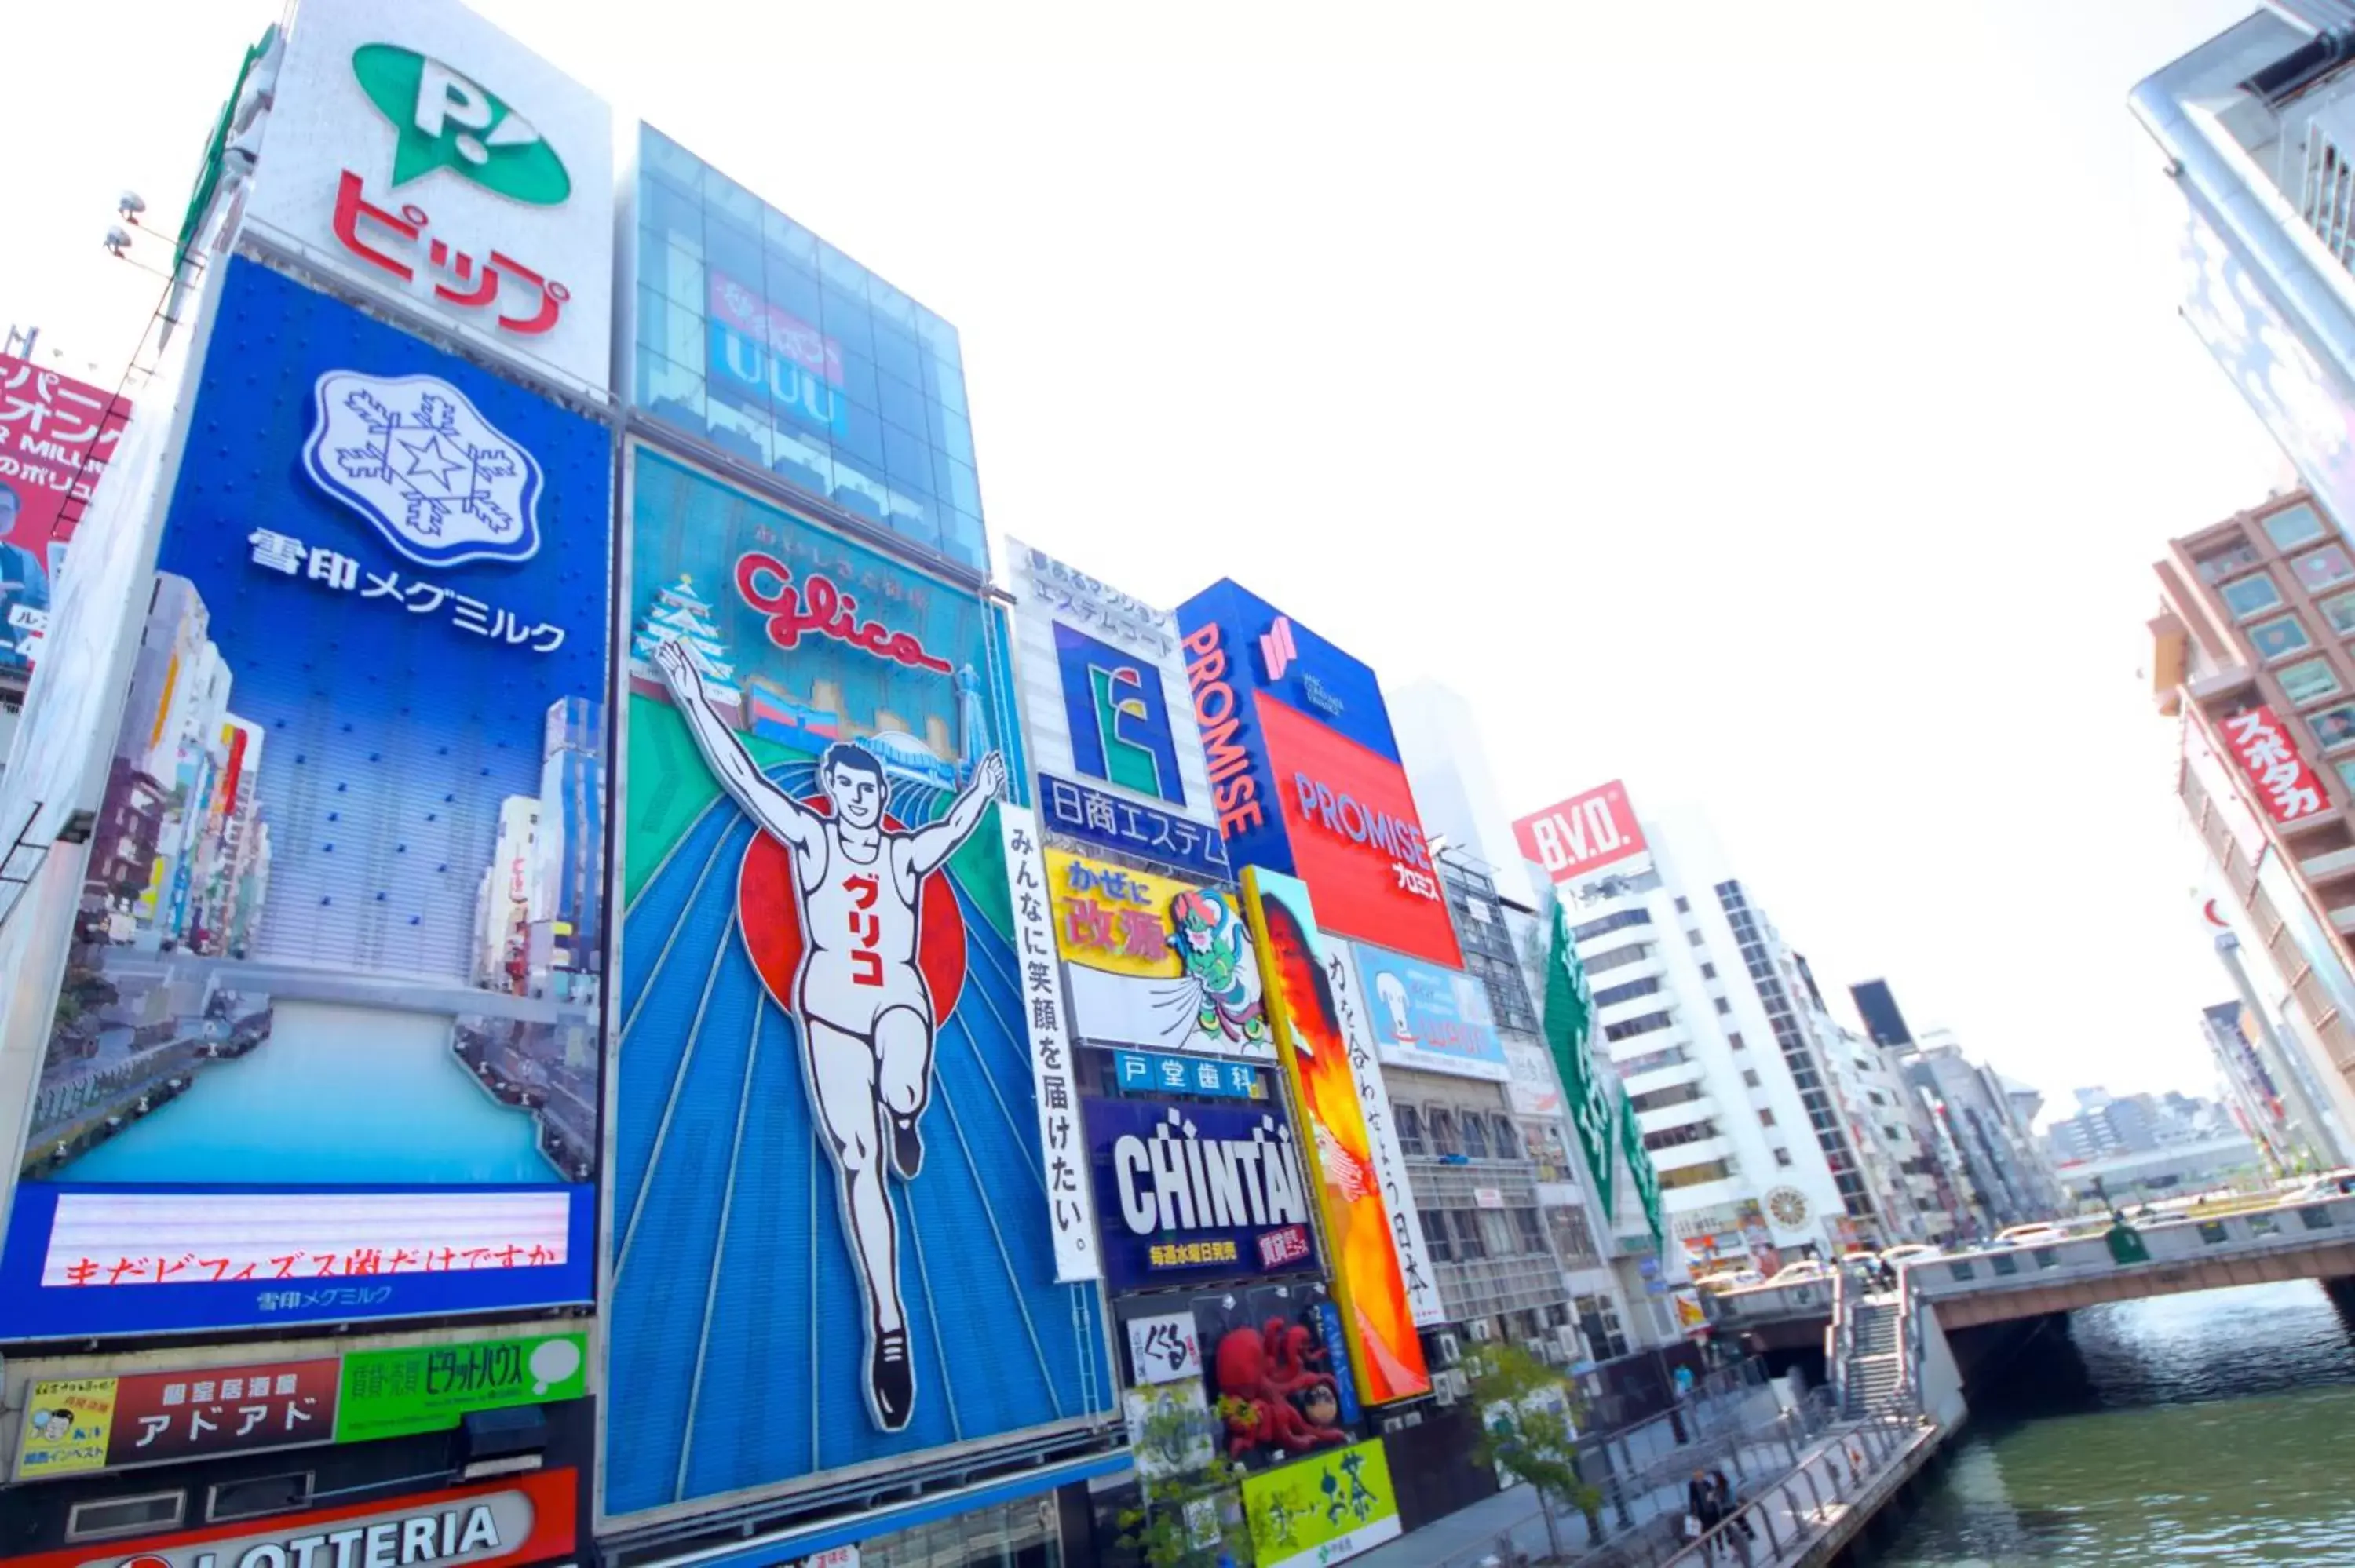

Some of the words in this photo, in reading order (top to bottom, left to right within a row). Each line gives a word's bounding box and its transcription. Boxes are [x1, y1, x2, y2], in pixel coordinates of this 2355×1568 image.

[333, 168, 571, 334] ピップ
[0, 365, 102, 410] パー
[247, 527, 565, 653] 雪印メグミルク
[734, 551, 954, 676] Glico
[1181, 621, 1264, 841] PROMISE
[2226, 712, 2320, 819] スポタカ
[1053, 782, 1228, 865] 日商エステム
[1294, 771, 1432, 871] PROMISE
[1532, 796, 1631, 872] B.V.D.
[1068, 860, 1153, 906] かぜに
[1392, 861, 1441, 903] プロミス
[842, 873, 884, 988] グリコ
[1064, 895, 1168, 961] 改源
[1011, 828, 1086, 1252] みんなに笑顔を届けたい。
[1123, 1055, 1251, 1096] 戸堂歯科
[1114, 1107, 1309, 1235] CHINTAI
[257, 1285, 392, 1311] 雪印メグミルク
[425, 1344, 523, 1395] ピタットハウス
[136, 1397, 317, 1447] アドアド
